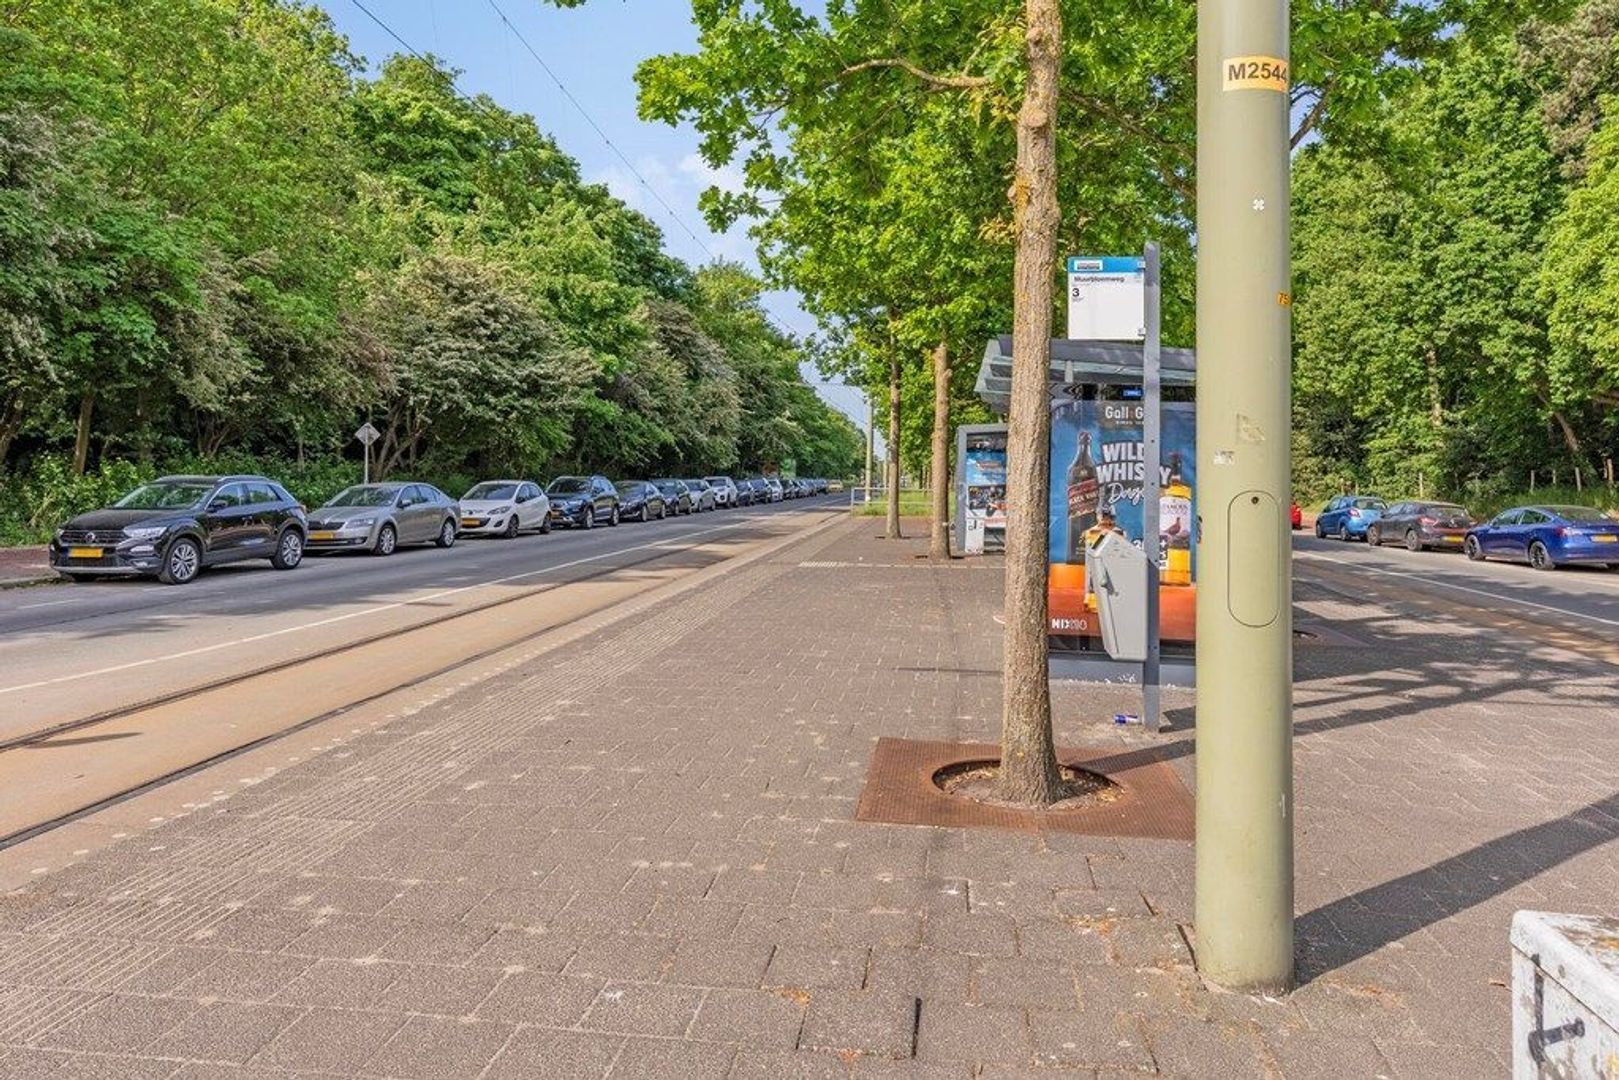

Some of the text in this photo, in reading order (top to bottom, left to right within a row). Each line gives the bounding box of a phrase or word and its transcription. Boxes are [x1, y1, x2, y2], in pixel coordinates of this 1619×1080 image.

[1228, 61, 1287, 83] M2544
[1072, 287, 1080, 297] 3
[1095, 461, 1172, 485] WHISY
